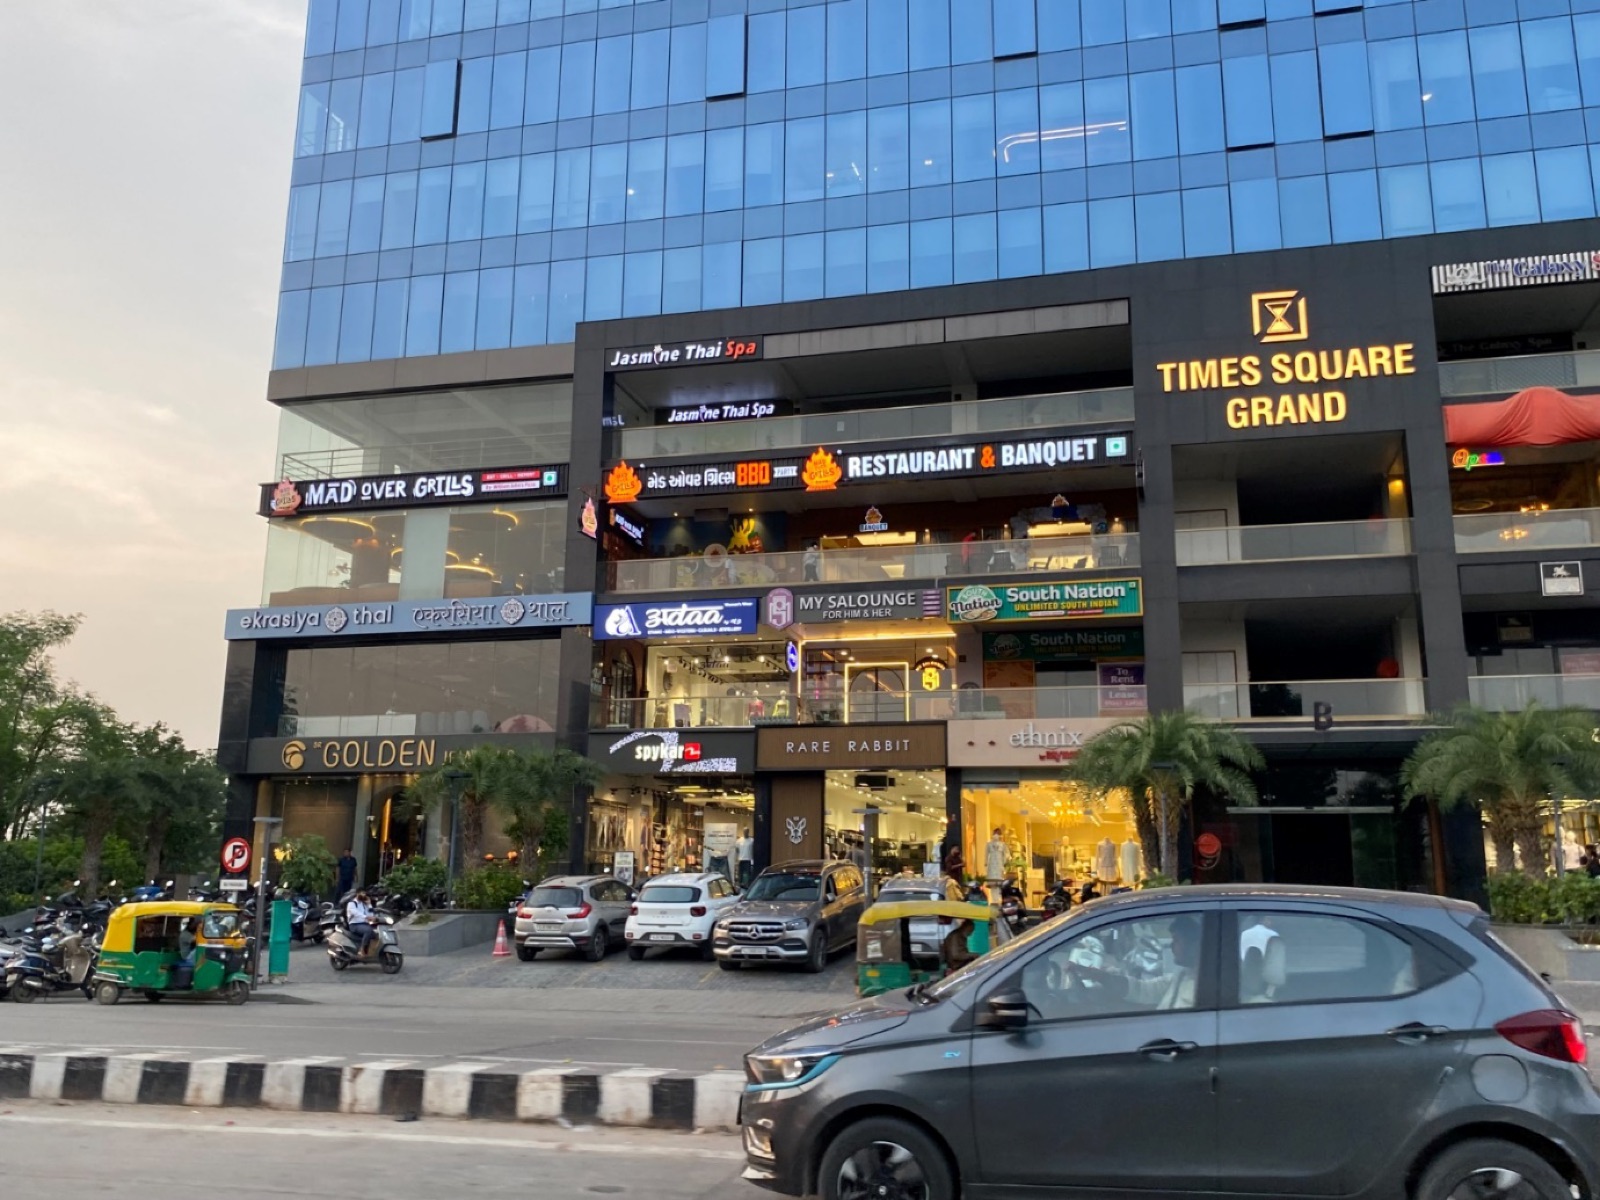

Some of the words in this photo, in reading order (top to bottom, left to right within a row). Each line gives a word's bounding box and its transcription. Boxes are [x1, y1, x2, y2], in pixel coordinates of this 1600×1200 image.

[1513, 258, 1586, 279] Galaxy
[611, 344, 680, 367] Jasmine
[685, 341, 723, 360] Thai
[725, 339, 757, 360] Spa
[1157, 355, 1262, 393] TIMES
[1270, 343, 1416, 385] SQUARE
[667, 405, 720, 423] Jasmine
[722, 403, 750, 419] Thai
[751, 402, 775, 418] Spa
[1226, 391, 1347, 429] GRAND
[848, 448, 975, 478] RESTAURANT
[981, 446, 996, 469] &
[1001, 437, 1097, 467] BANQUET
[1452, 448, 1504, 471] Op
[305, 479, 356, 506] MAD
[361, 480, 407, 501] OVER
[413, 474, 474, 500] GRILLS
[800, 596, 824, 610] MY
[828, 592, 916, 609] SALOUNGE
[1006, 586, 1061, 603] South
[1064, 584, 1126, 600] Nation
[822, 610, 842, 619] FOR
[843, 609, 861, 619] HIM
[863, 609, 869, 618] &
[872, 608, 892, 618] HER
[951, 598, 1000, 613] Nation
[1014, 601, 1059, 612] UNLIMITED
[1061, 601, 1087, 610] SOUTH
[1090, 599, 1119, 609] INDIAN
[240, 610, 321, 633] ekrasiya
[353, 605, 394, 625] thal
[1030, 633, 1074, 646] South
[1076, 632, 1126, 645] Nation
[1116, 667, 1129, 676] To
[1109, 691, 1138, 699] Lease
[1313, 701, 1333, 731] B
[786, 741, 831, 753] RARE
[848, 739, 910, 752] RABBIT
[1009, 722, 1083, 749] ethnix
[323, 739, 436, 768] GOLDEN
[635, 743, 685, 762] spykar
